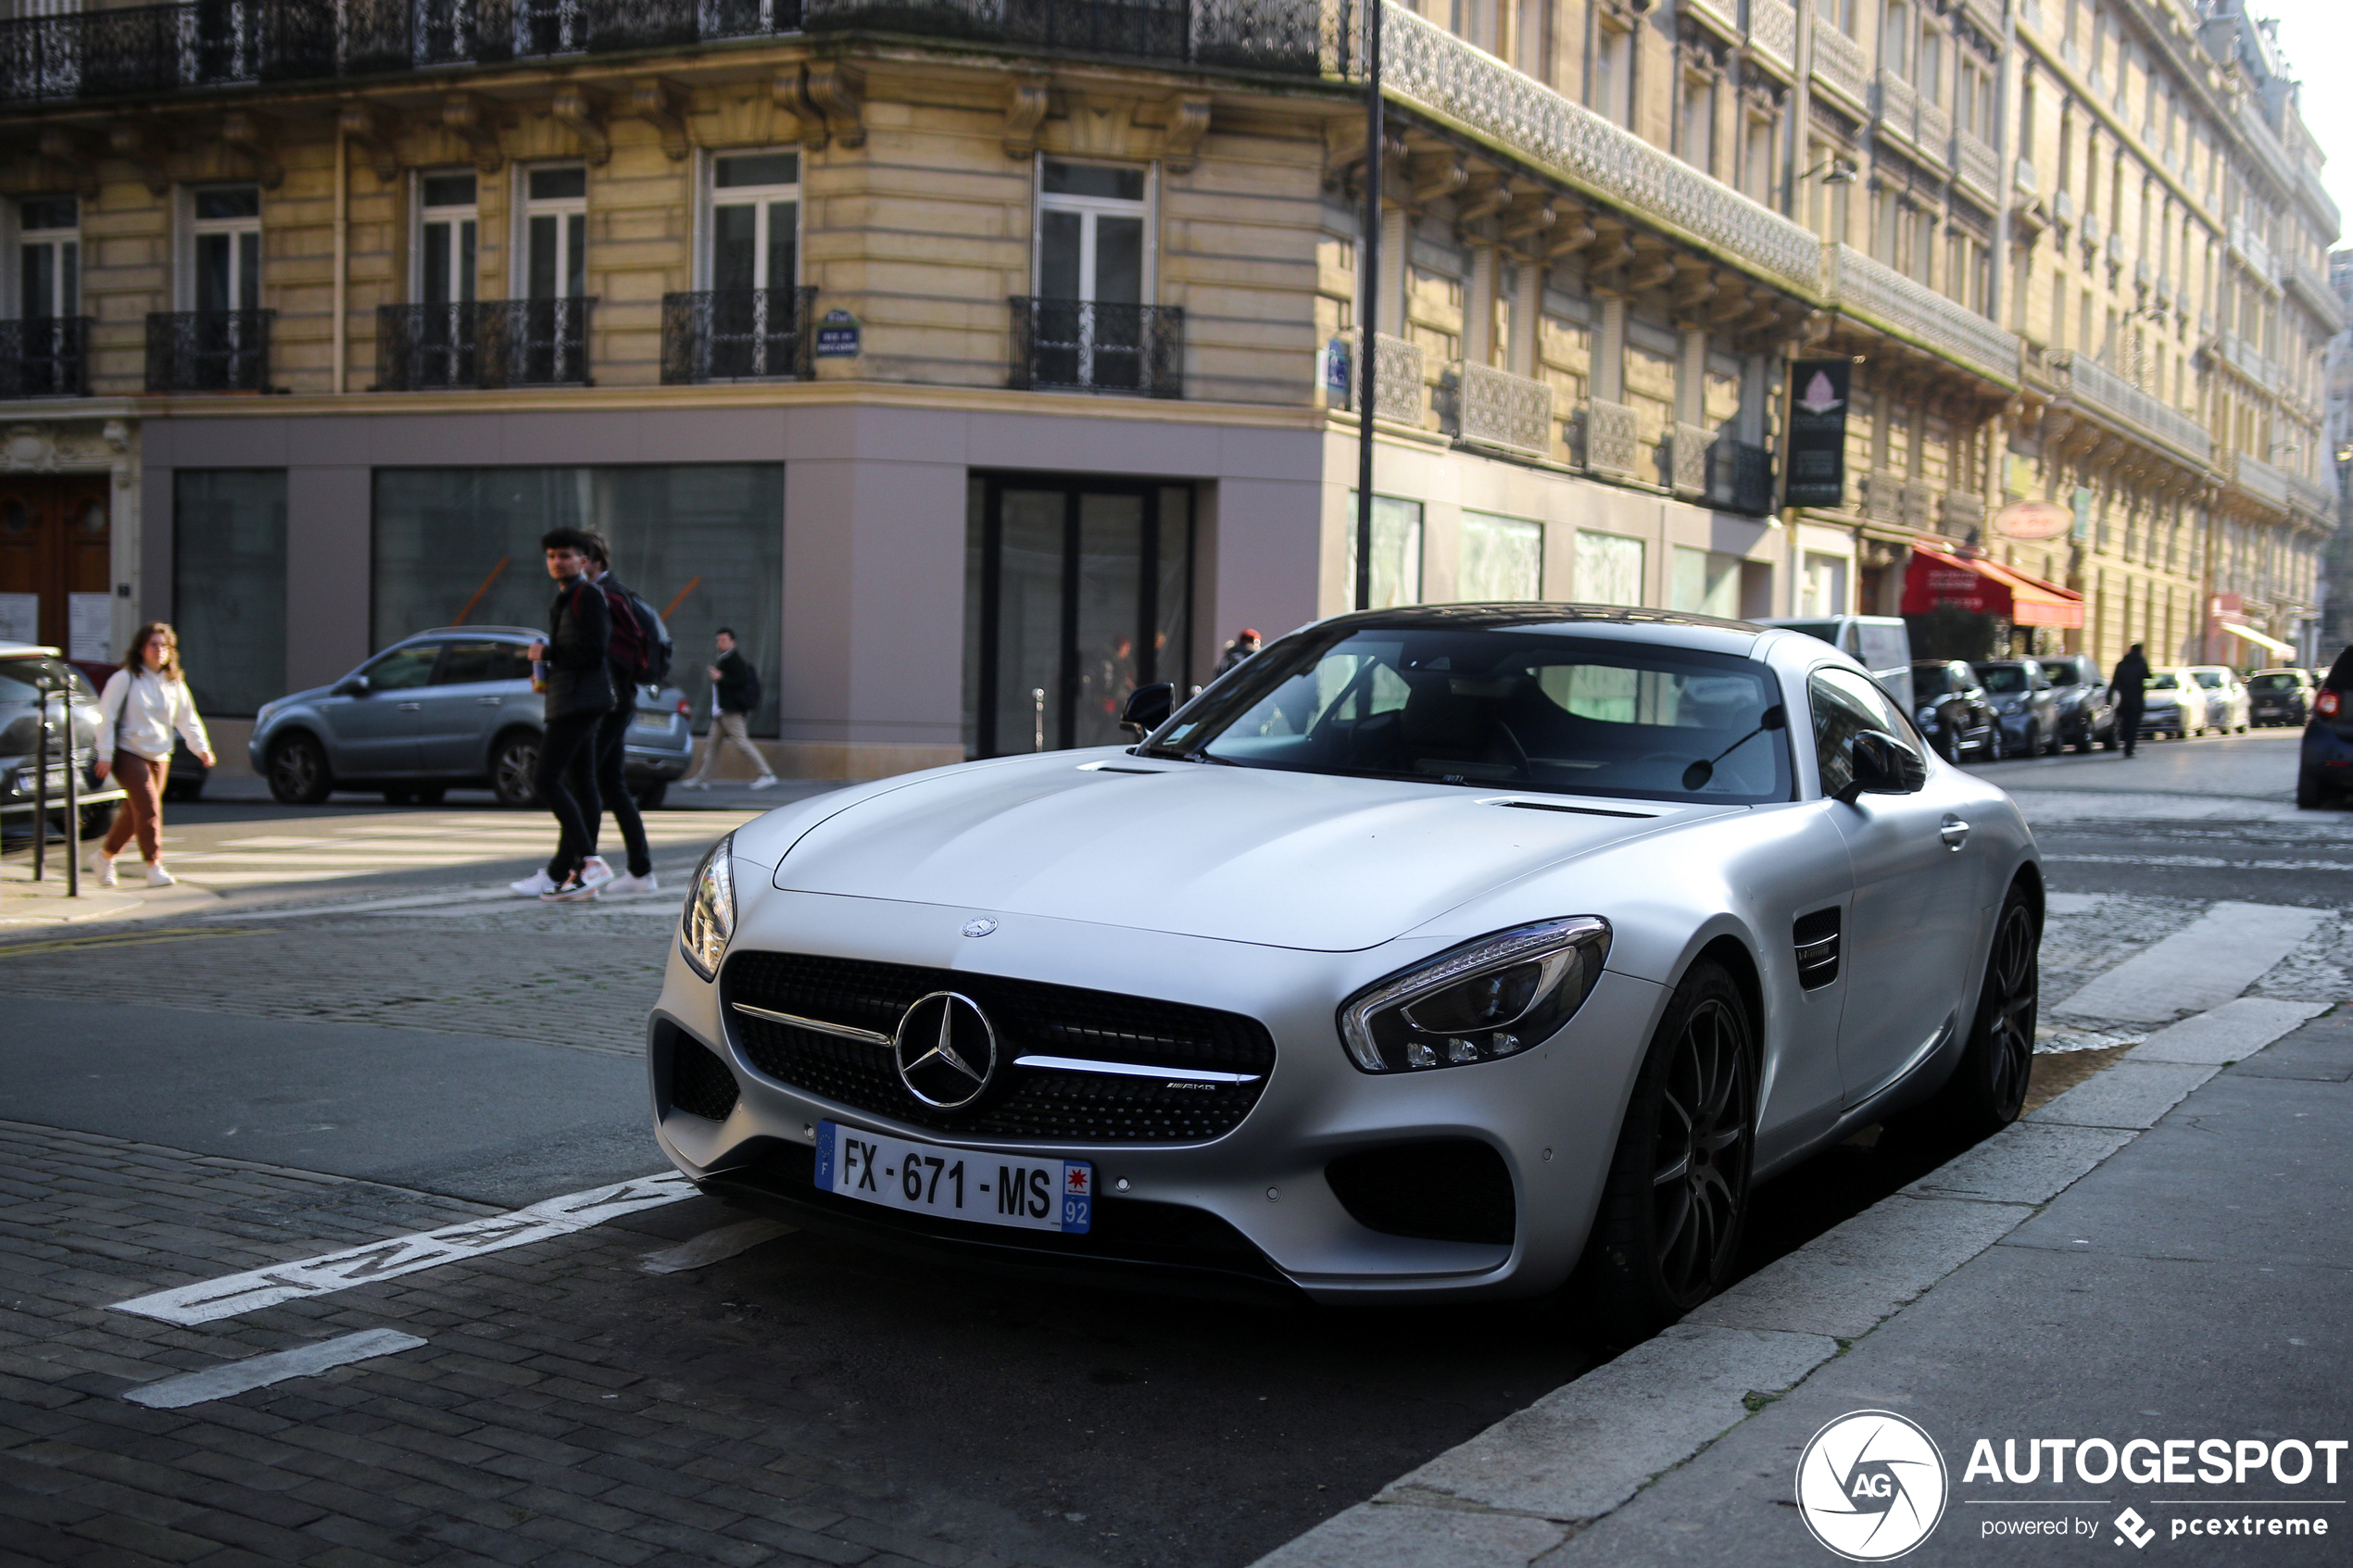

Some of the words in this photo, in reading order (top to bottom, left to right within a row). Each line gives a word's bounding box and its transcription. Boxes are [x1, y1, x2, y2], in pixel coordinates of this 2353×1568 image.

[1182, 1083, 1215, 1091] AMG
[821, 1162, 828, 1175] F
[1064, 1200, 1088, 1225] 92
